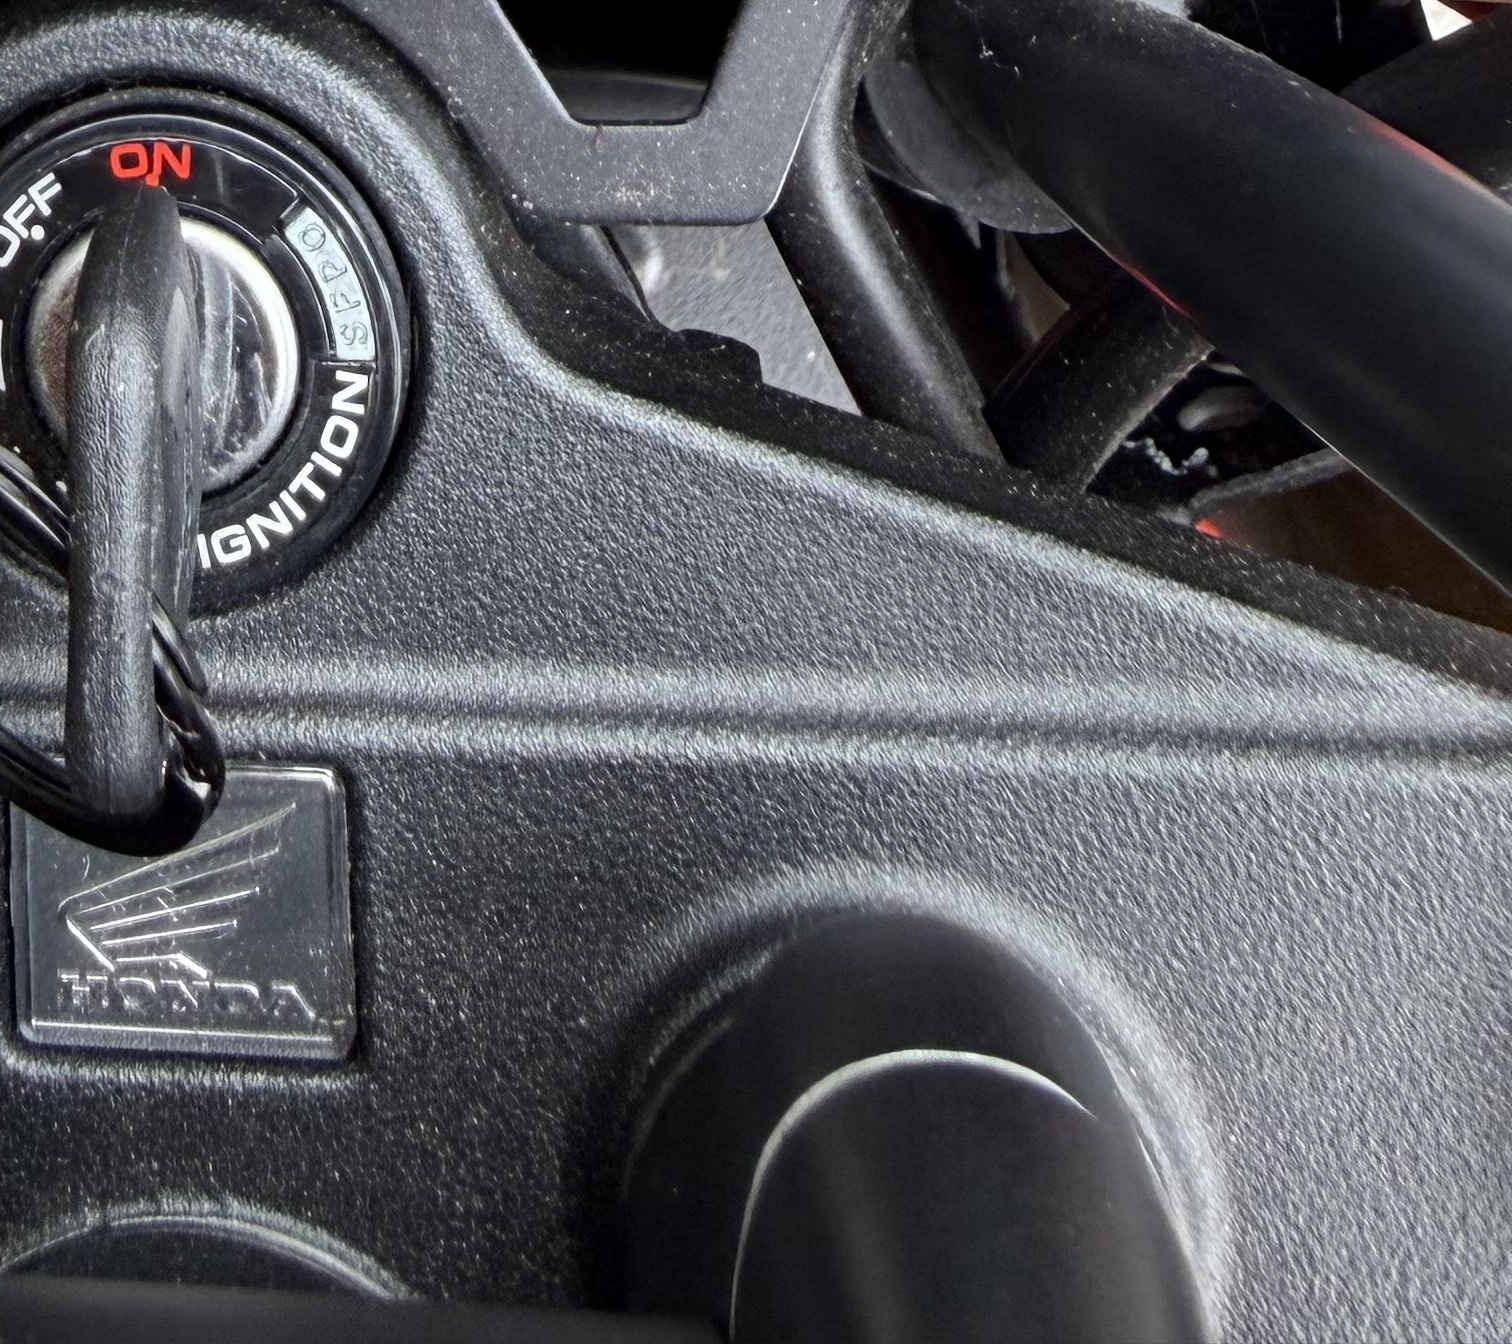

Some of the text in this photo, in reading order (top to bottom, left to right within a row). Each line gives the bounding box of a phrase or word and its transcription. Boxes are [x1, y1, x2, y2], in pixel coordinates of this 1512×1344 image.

[109, 141, 192, 186] ON
[196, 368, 371, 571] IGNITION
[57, 967, 316, 1020] HONDA
